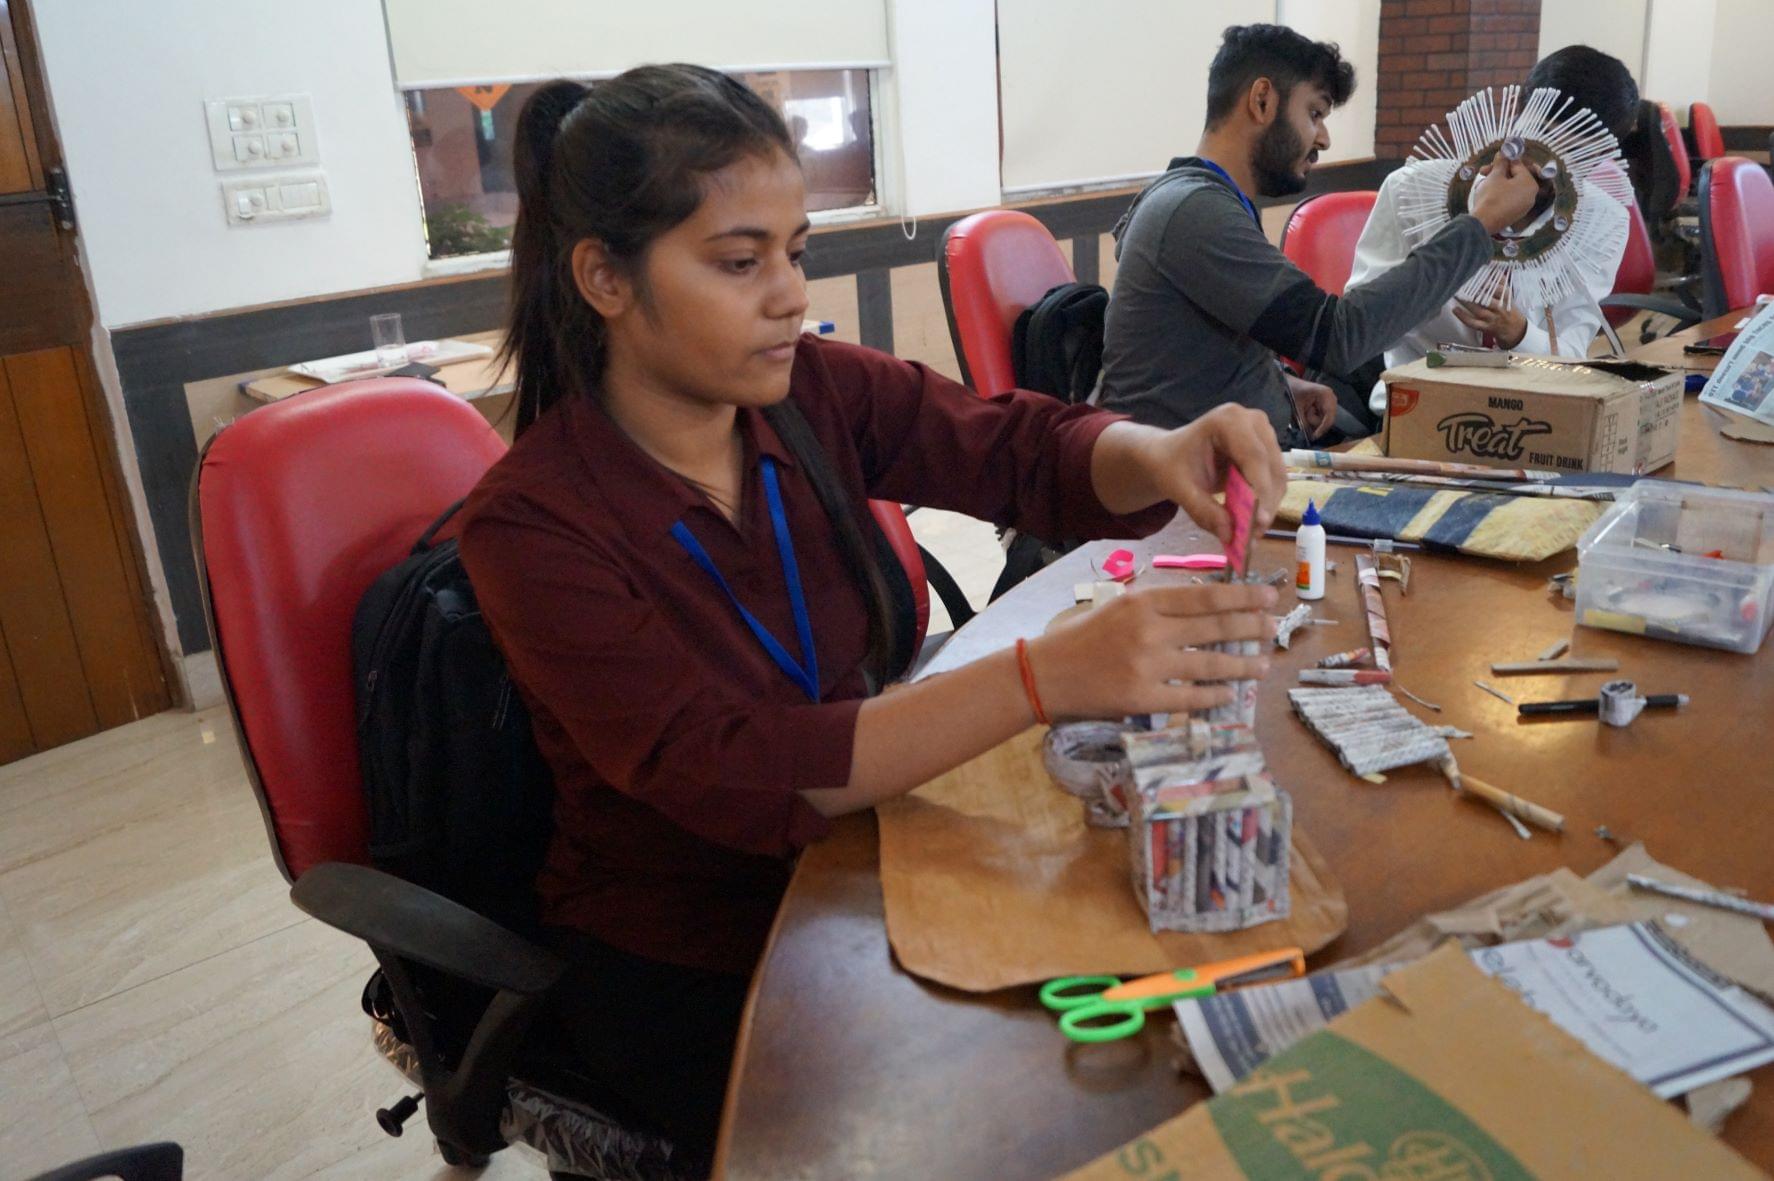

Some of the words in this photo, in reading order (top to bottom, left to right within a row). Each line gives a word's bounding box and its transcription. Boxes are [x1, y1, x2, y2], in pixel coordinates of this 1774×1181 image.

[1488, 396, 1524, 410] MANGO
[1437, 412, 1552, 461] Treat
[1529, 452, 1553, 466] FRUIT
[1555, 456, 1584, 470] DRINK
